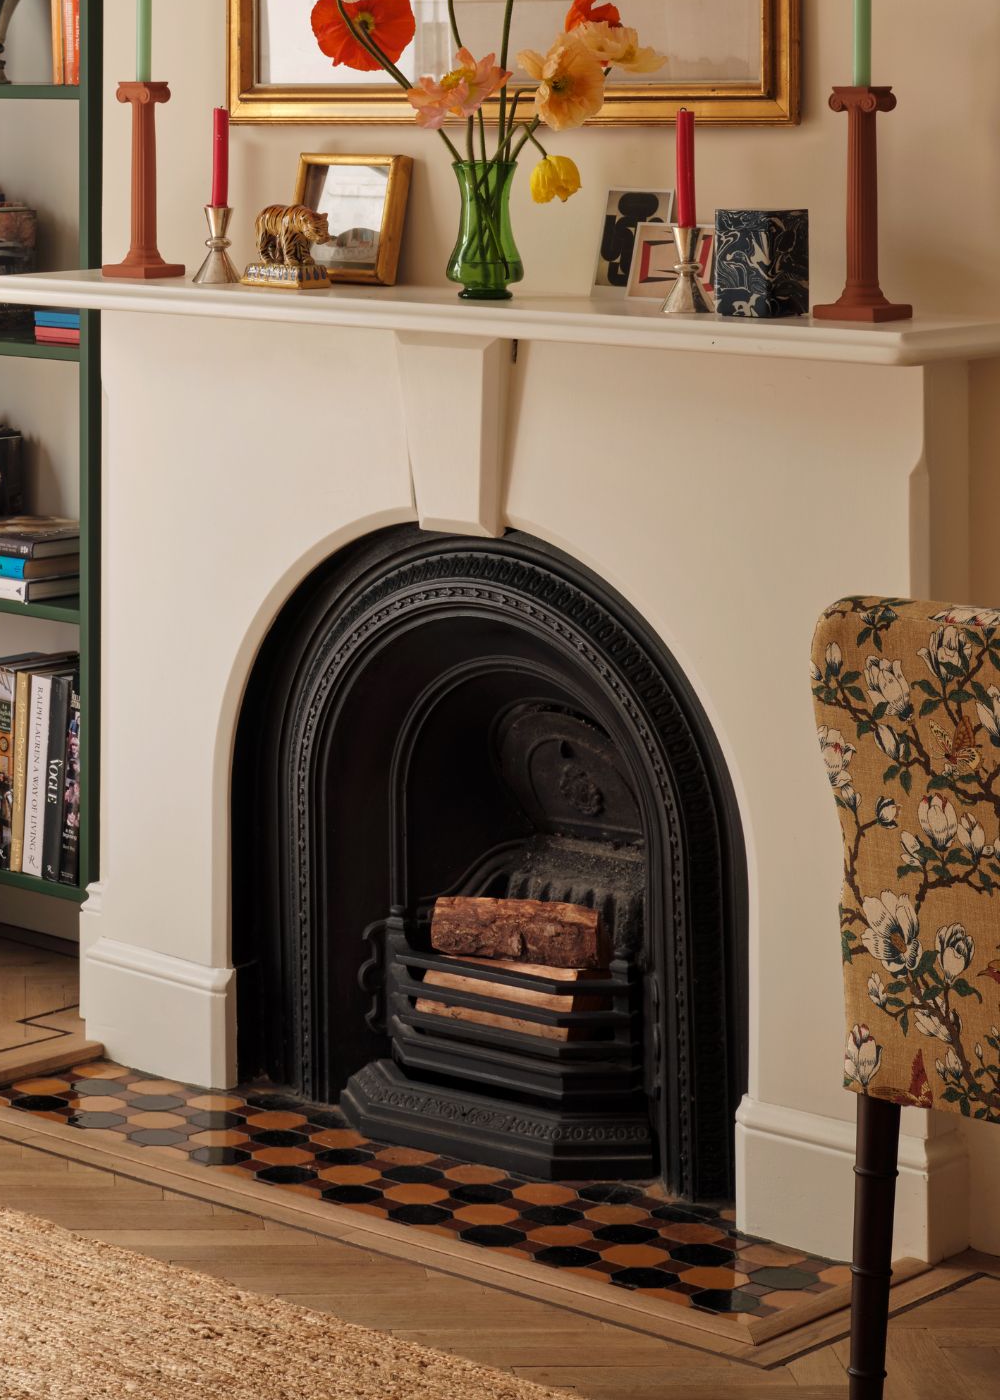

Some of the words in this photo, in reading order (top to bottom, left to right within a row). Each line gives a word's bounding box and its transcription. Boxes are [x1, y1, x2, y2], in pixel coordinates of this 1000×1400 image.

[36, 686, 44, 719] RALPH
[47, 759, 61, 803] VOGUE
[31, 799, 38, 812] OF
[29, 815, 37, 851] LIVING
